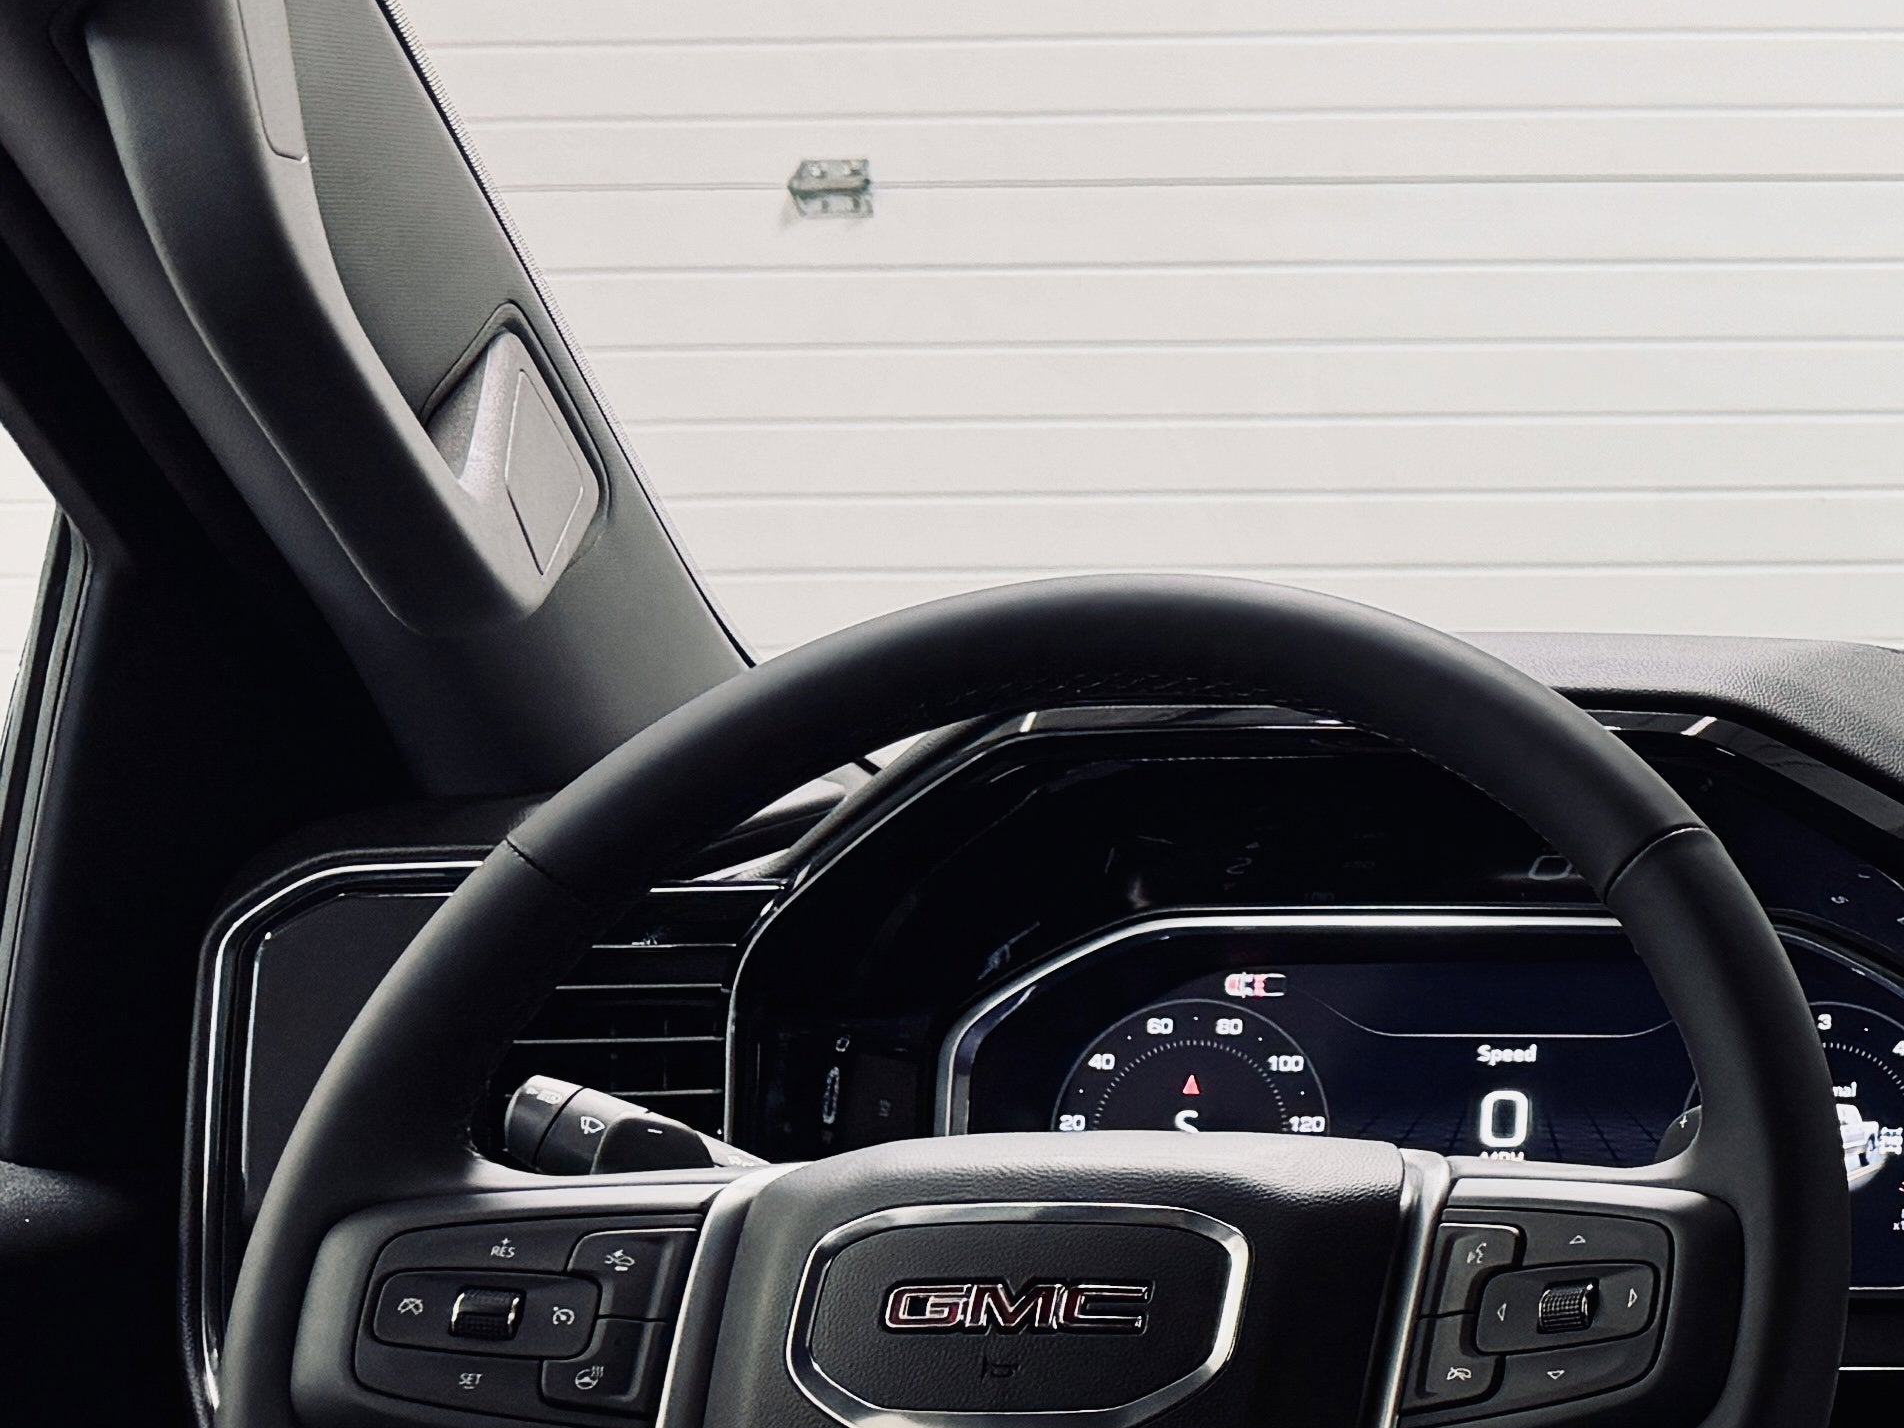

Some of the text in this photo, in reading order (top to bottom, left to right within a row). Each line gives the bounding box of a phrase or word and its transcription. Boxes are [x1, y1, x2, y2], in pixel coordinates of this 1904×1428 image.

[1146, 1018, 1173, 1035] 60
[1215, 1018, 1243, 1035] 80
[1817, 1014, 1832, 1030] 3
[1088, 1053, 1115, 1070] 40
[1268, 1055, 1304, 1072] 100
[1476, 1044, 1537, 1066] Speed
[1059, 1115, 1086, 1132] 20
[1174, 1109, 1199, 1133] S
[1289, 1116, 1325, 1133] 120
[1479, 1090, 1529, 1148] 0
[491, 1245, 515, 1258] RES
[882, 1279, 1154, 1333] GMC
[459, 1373, 482, 1385] SET
